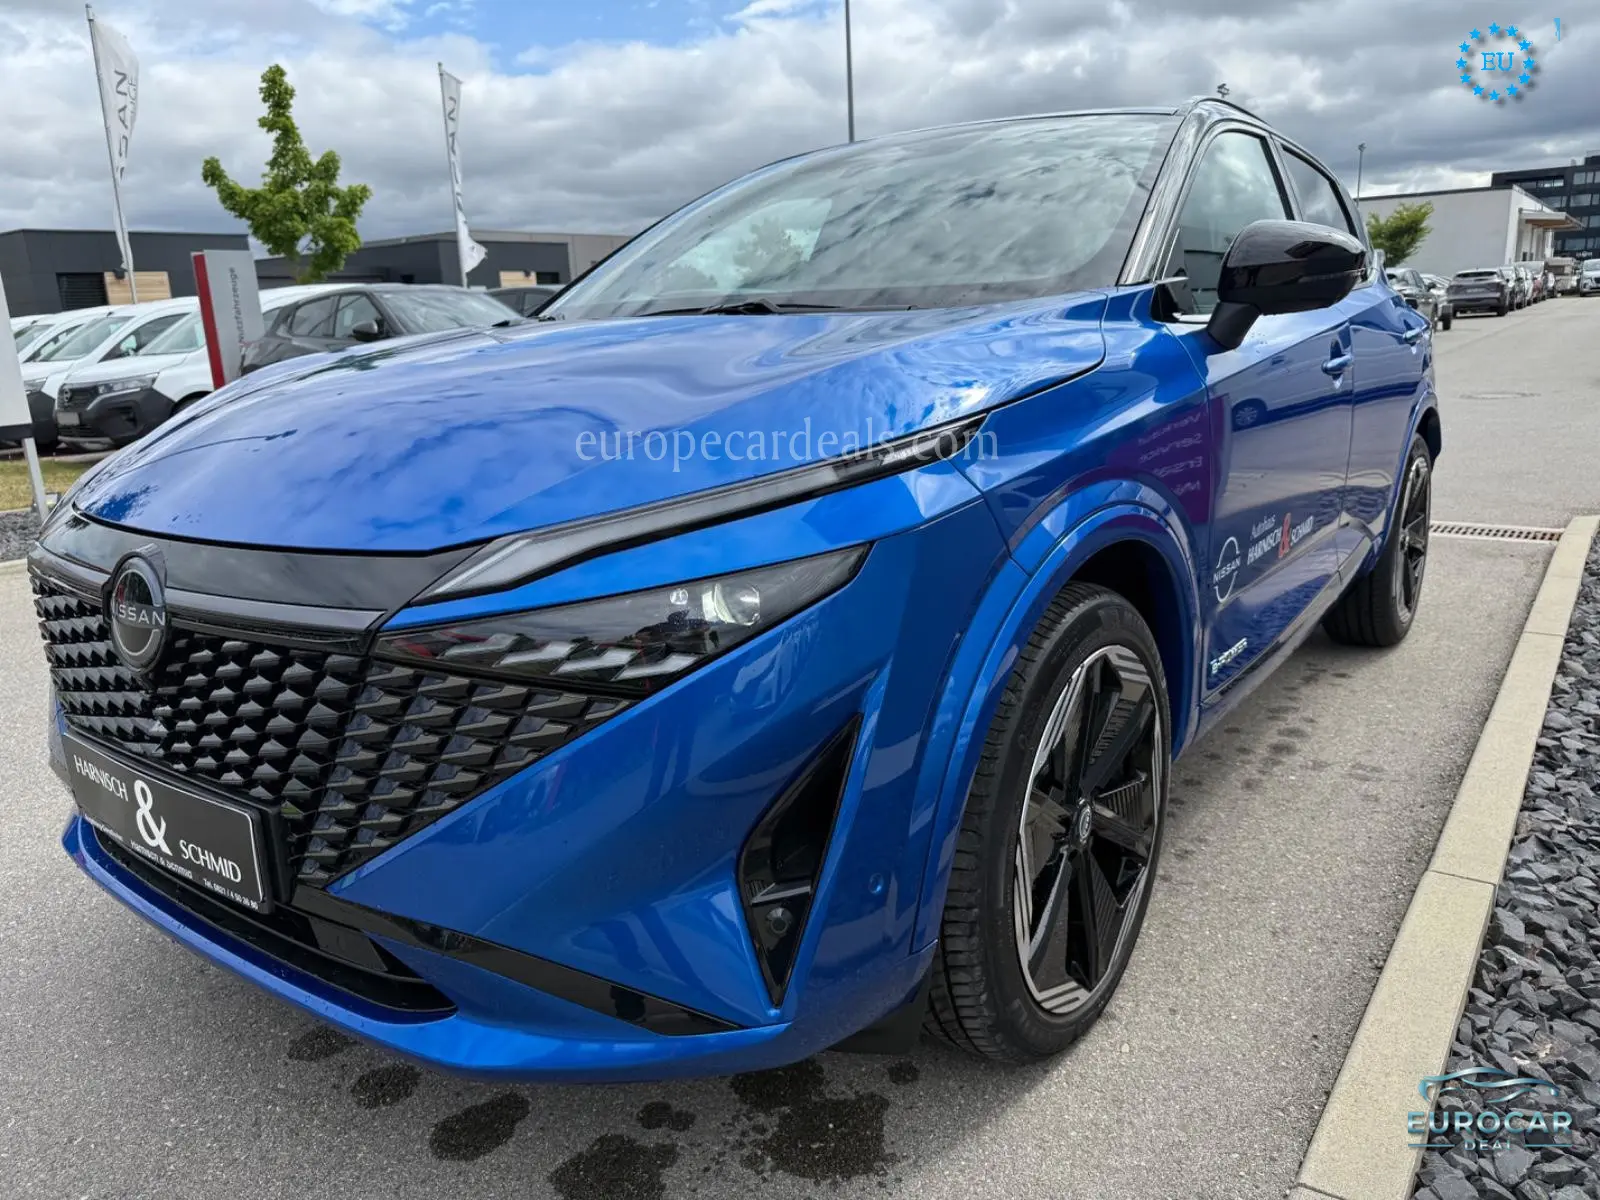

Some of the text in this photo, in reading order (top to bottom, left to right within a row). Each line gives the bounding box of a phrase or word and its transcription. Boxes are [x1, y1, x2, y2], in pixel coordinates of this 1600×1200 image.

[1278, 512, 1291, 559] &
[1213, 556, 1241, 584] NISSAN
[113, 604, 166, 626] SSAN
[73, 754, 129, 802] HARNISCH
[134, 779, 173, 857] &
[179, 839, 242, 883] SCHMID
